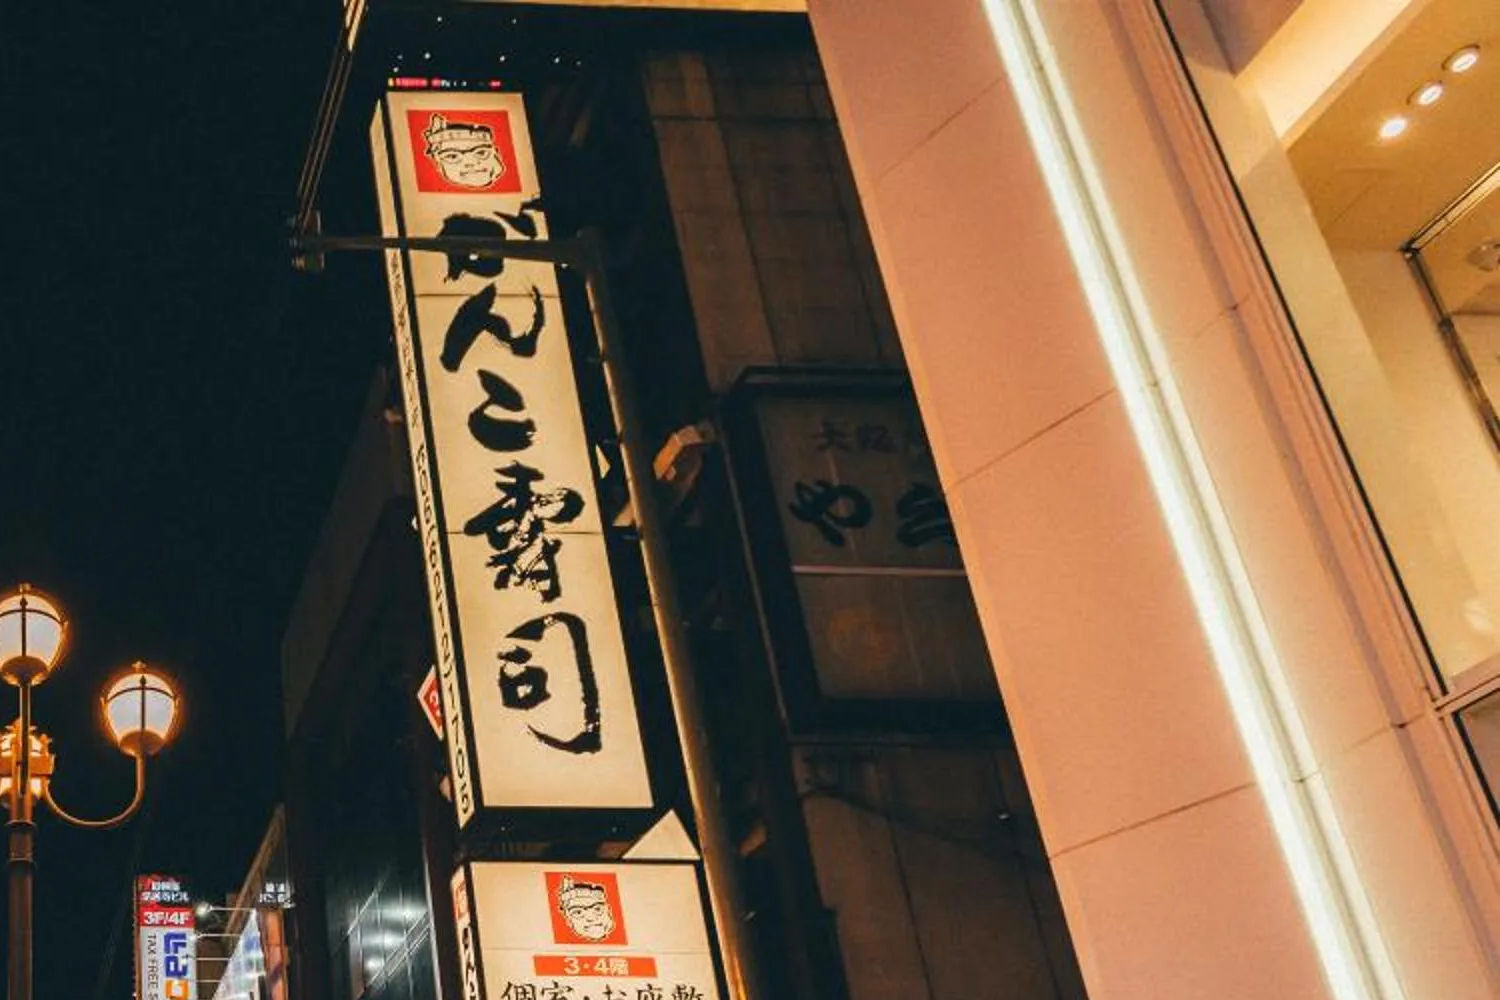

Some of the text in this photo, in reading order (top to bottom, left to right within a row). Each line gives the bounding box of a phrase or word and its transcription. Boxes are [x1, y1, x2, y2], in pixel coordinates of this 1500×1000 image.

[148, 935, 156, 955] TAX
[148, 960, 159, 989] FREE
[563, 957, 629, 975] 3・4階
